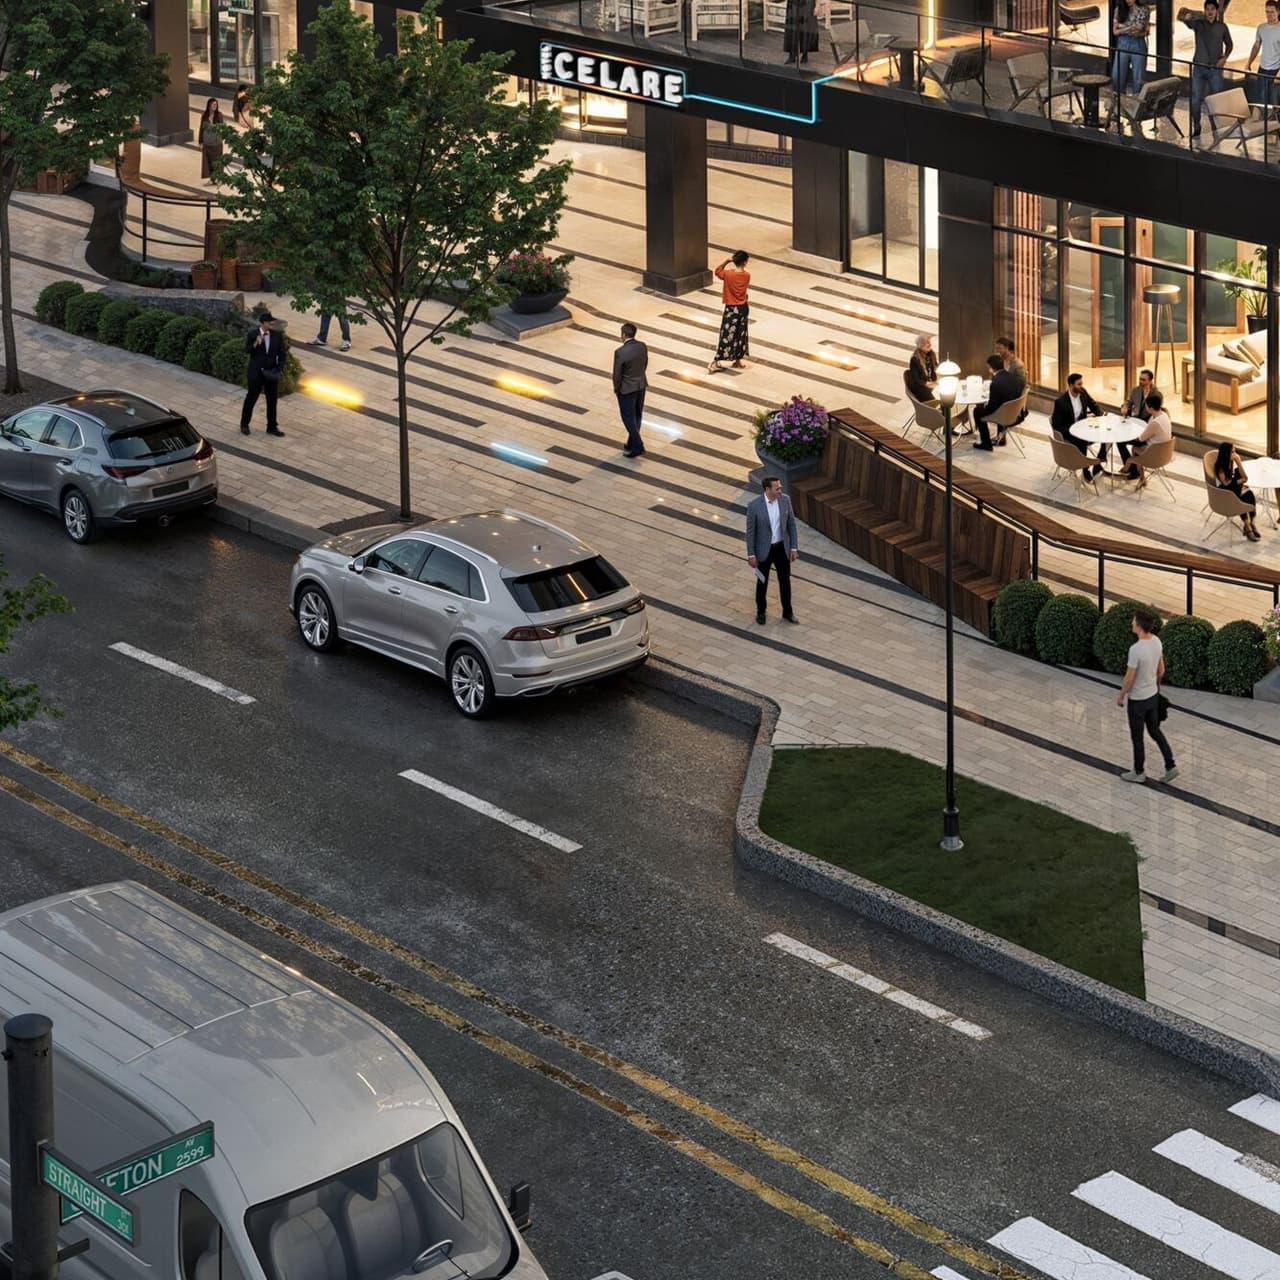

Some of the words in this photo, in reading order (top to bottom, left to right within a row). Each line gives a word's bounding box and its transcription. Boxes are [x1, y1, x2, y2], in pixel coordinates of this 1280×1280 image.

[554, 52, 683, 103] CELARE
[176, 1146, 204, 1167] 2599
[49, 1163, 106, 1217] STRAIGHT
